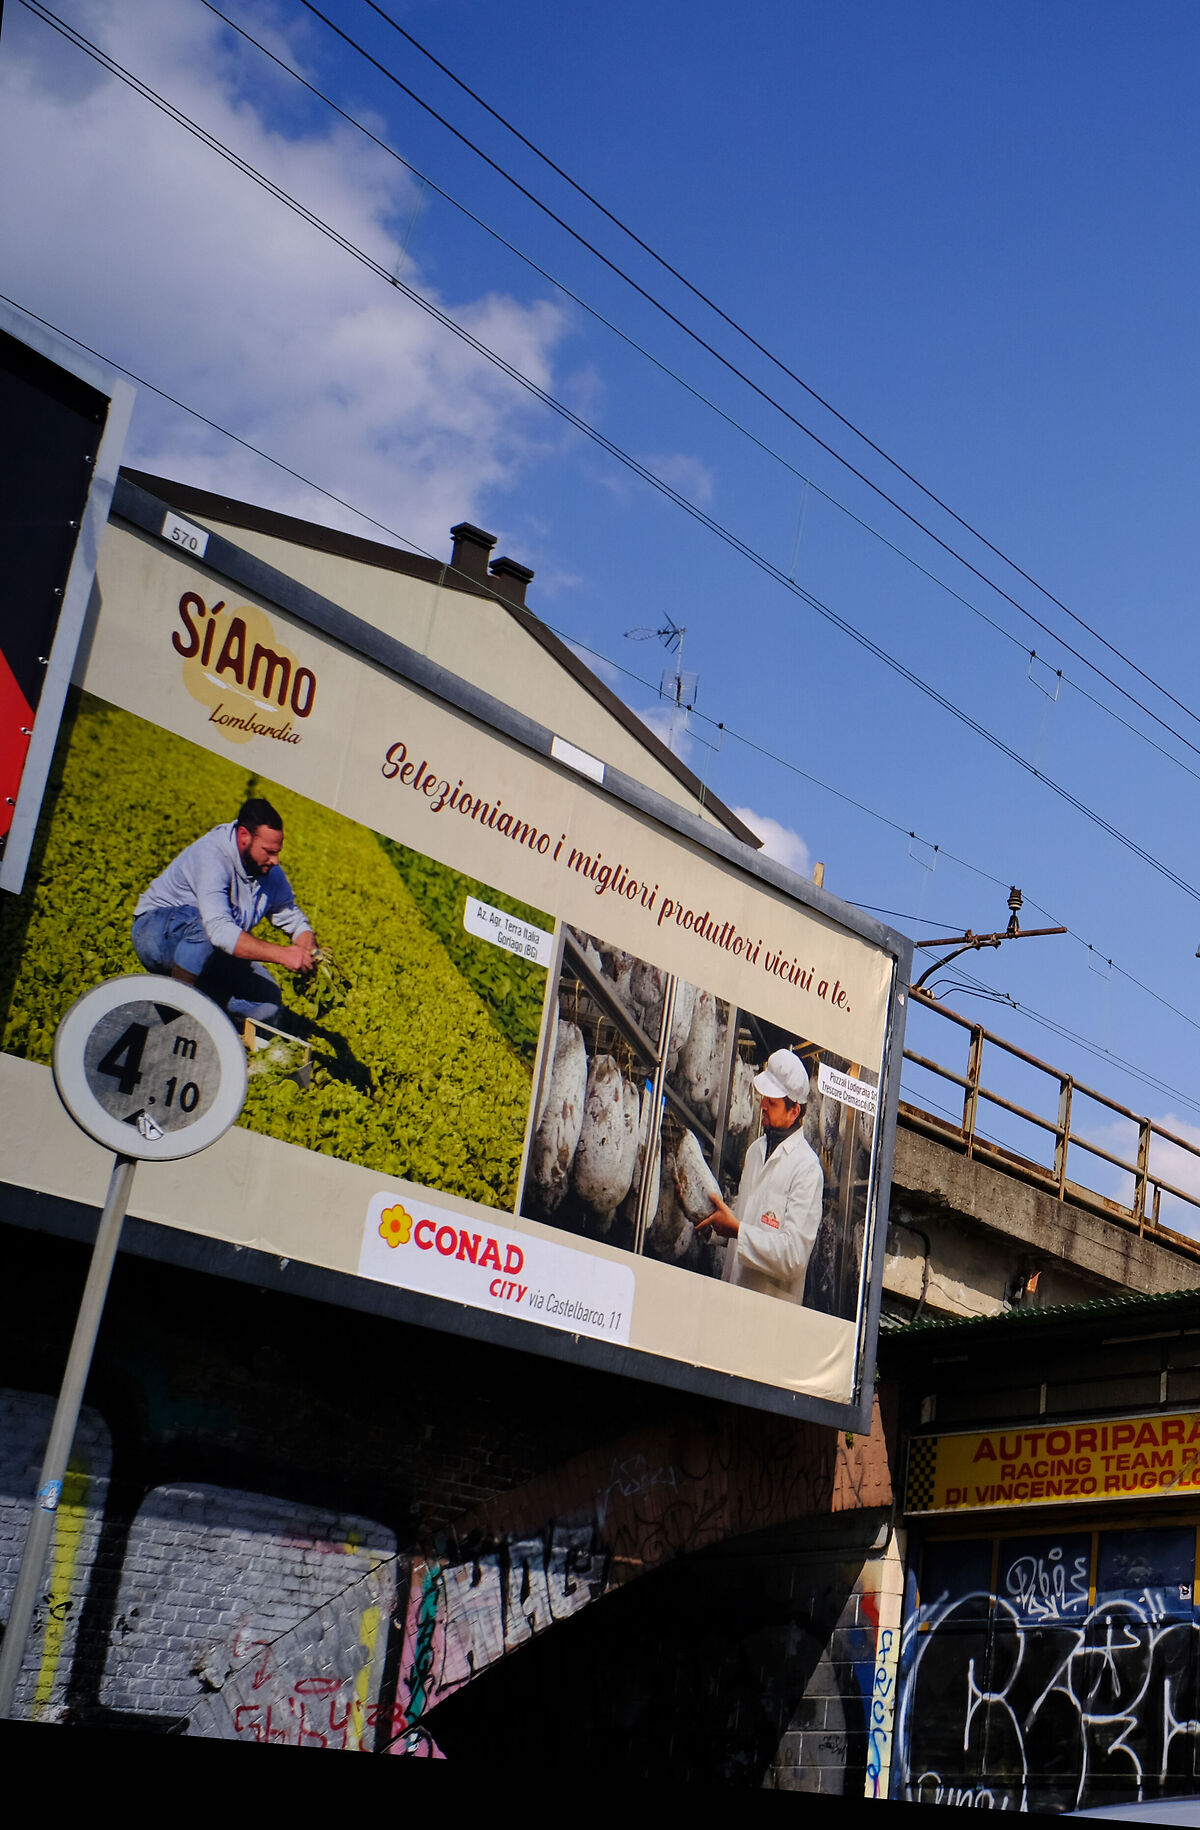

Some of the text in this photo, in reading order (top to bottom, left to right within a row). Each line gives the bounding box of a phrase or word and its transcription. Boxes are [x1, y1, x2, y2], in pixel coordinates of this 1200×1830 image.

[172, 527, 198, 551] 570
[172, 591, 316, 718] SíAmo
[208, 703, 303, 745] Lombardia
[381, 742, 551, 855] Selezioniamo
[553, 834, 566, 861] i
[567, 848, 660, 911] migliori
[657, 897, 763, 965] produttori
[764, 950, 816, 993] vicini
[817, 978, 829, 1000] a
[477, 906, 488, 921] Az.
[489, 912, 503, 928] Agr.
[505, 918, 522, 937] Terra
[497, 931, 538, 960] Gorlago (BG)
[97, 1022, 198, 1096] 4 m
[414, 1219, 525, 1275] CONAD
[489, 1278, 529, 1303] CITY
[546, 1293, 606, 1328] Castelbarco,
[609, 1310, 622, 1331] 11
[1001, 1456, 1092, 1481] RACING
[1101, 1450, 1173, 1472] TEAM
[945, 1487, 968, 1505] DI
[975, 1477, 1097, 1502] VINCENZO
